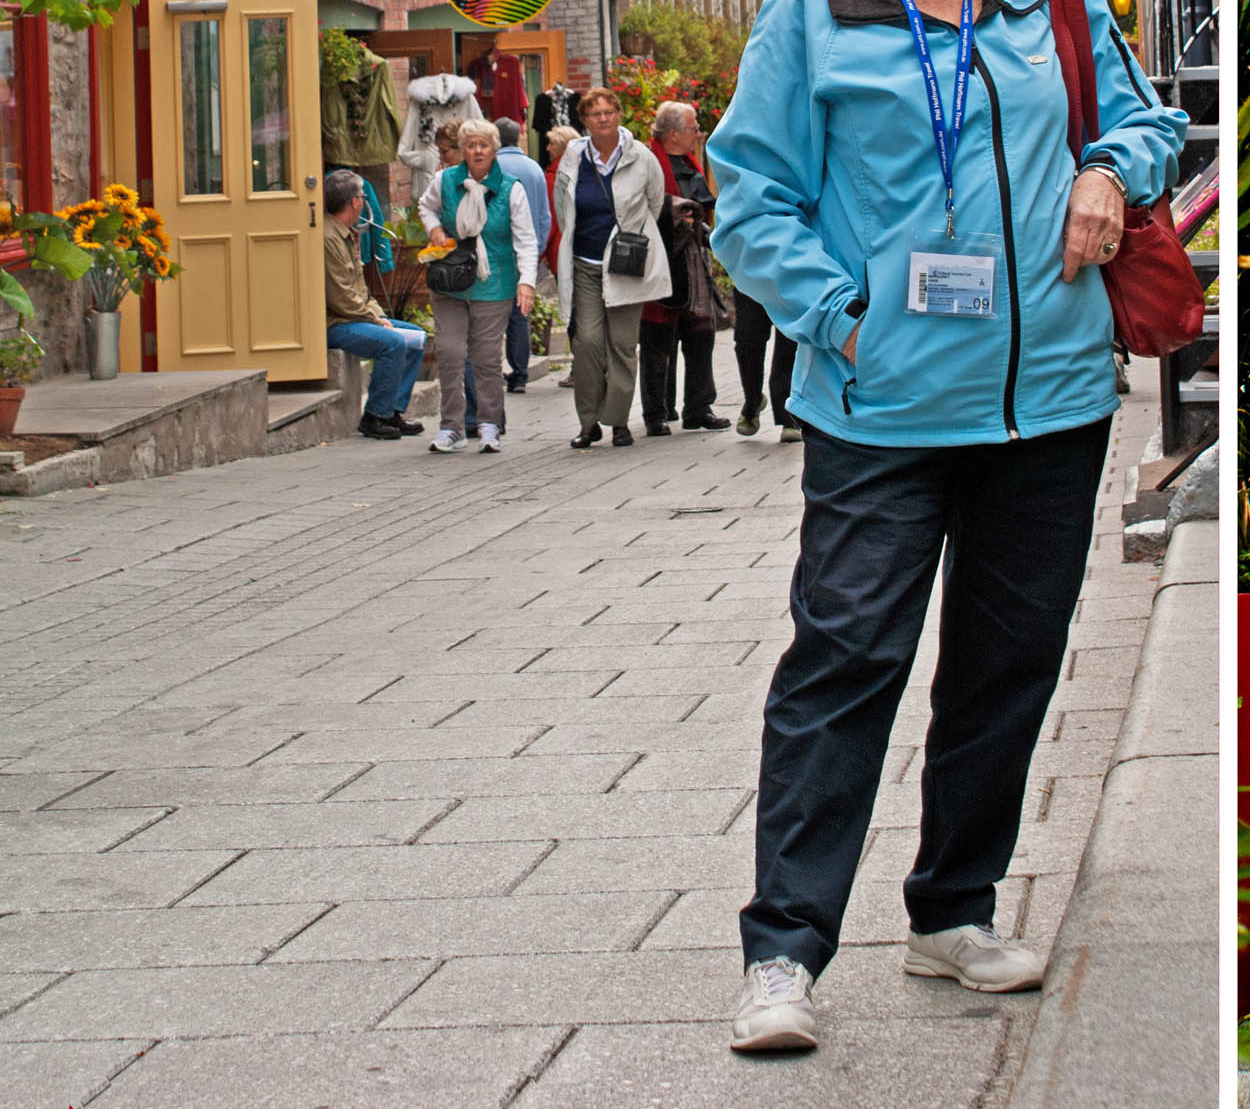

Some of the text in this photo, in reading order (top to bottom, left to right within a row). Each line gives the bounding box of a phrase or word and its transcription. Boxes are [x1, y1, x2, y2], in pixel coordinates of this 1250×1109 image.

[924, 62, 933, 79] Travel
[955, 111, 963, 130] Travel
[972, 297, 990, 310] 09
